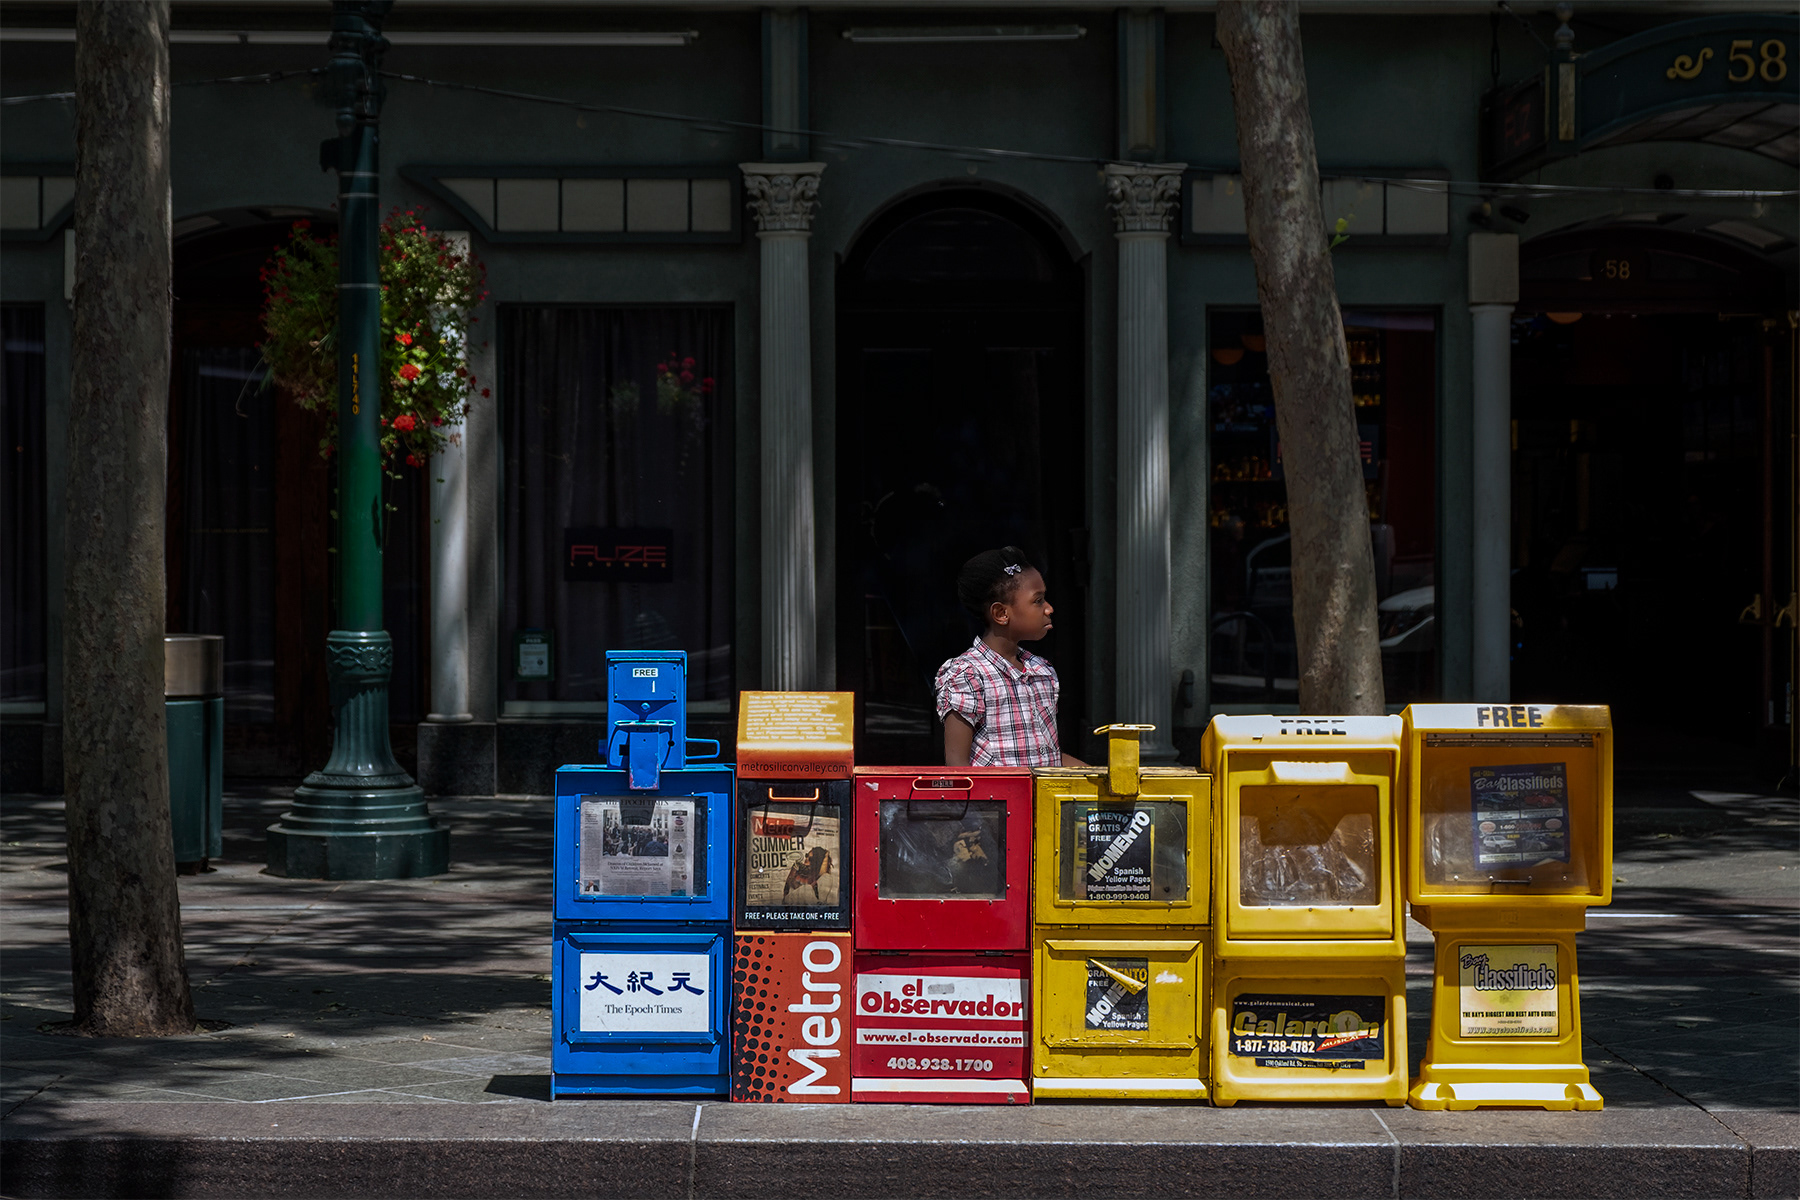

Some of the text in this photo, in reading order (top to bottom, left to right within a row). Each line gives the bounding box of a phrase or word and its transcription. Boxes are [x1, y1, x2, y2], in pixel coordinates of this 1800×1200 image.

[1728, 39, 1788, 82] 58
[1606, 259, 1630, 280] 58
[570, 544, 667, 562] FUZE
[634, 669, 656, 677] FREE
[1476, 706, 1544, 728] FREE
[741, 762, 848, 775] metrosiliconvalley.com
[1474, 776, 1564, 791] Bay Classifieds
[1088, 812, 1129, 824] MOMENTO
[1088, 824, 1121, 833] GRATIS
[752, 835, 805, 853] SUMMER
[1088, 811, 1150, 882] MOMENTO
[751, 852, 788, 870] GUIDE
[1114, 867, 1144, 876] Spanish
[1130, 876, 1151, 884] Pages
[745, 912, 840, 920] FREE PLEASE TAKE ONE FREE
[1460, 953, 1489, 970] Bay
[584, 970, 704, 996] 大紀元
[1474, 963, 1556, 992] Classifieds
[902, 978, 923, 996] el
[604, 1004, 682, 1016] The Epoch Times
[860, 991, 1023, 1017] Observador
[788, 940, 842, 1095] Metro
[1102, 1020, 1125, 1028] Yellow
[1112, 1012, 1142, 1020] Spanish
[863, 1032, 1022, 1045] www.el-observador.com
[887, 1057, 994, 1072] 408.938.1700
